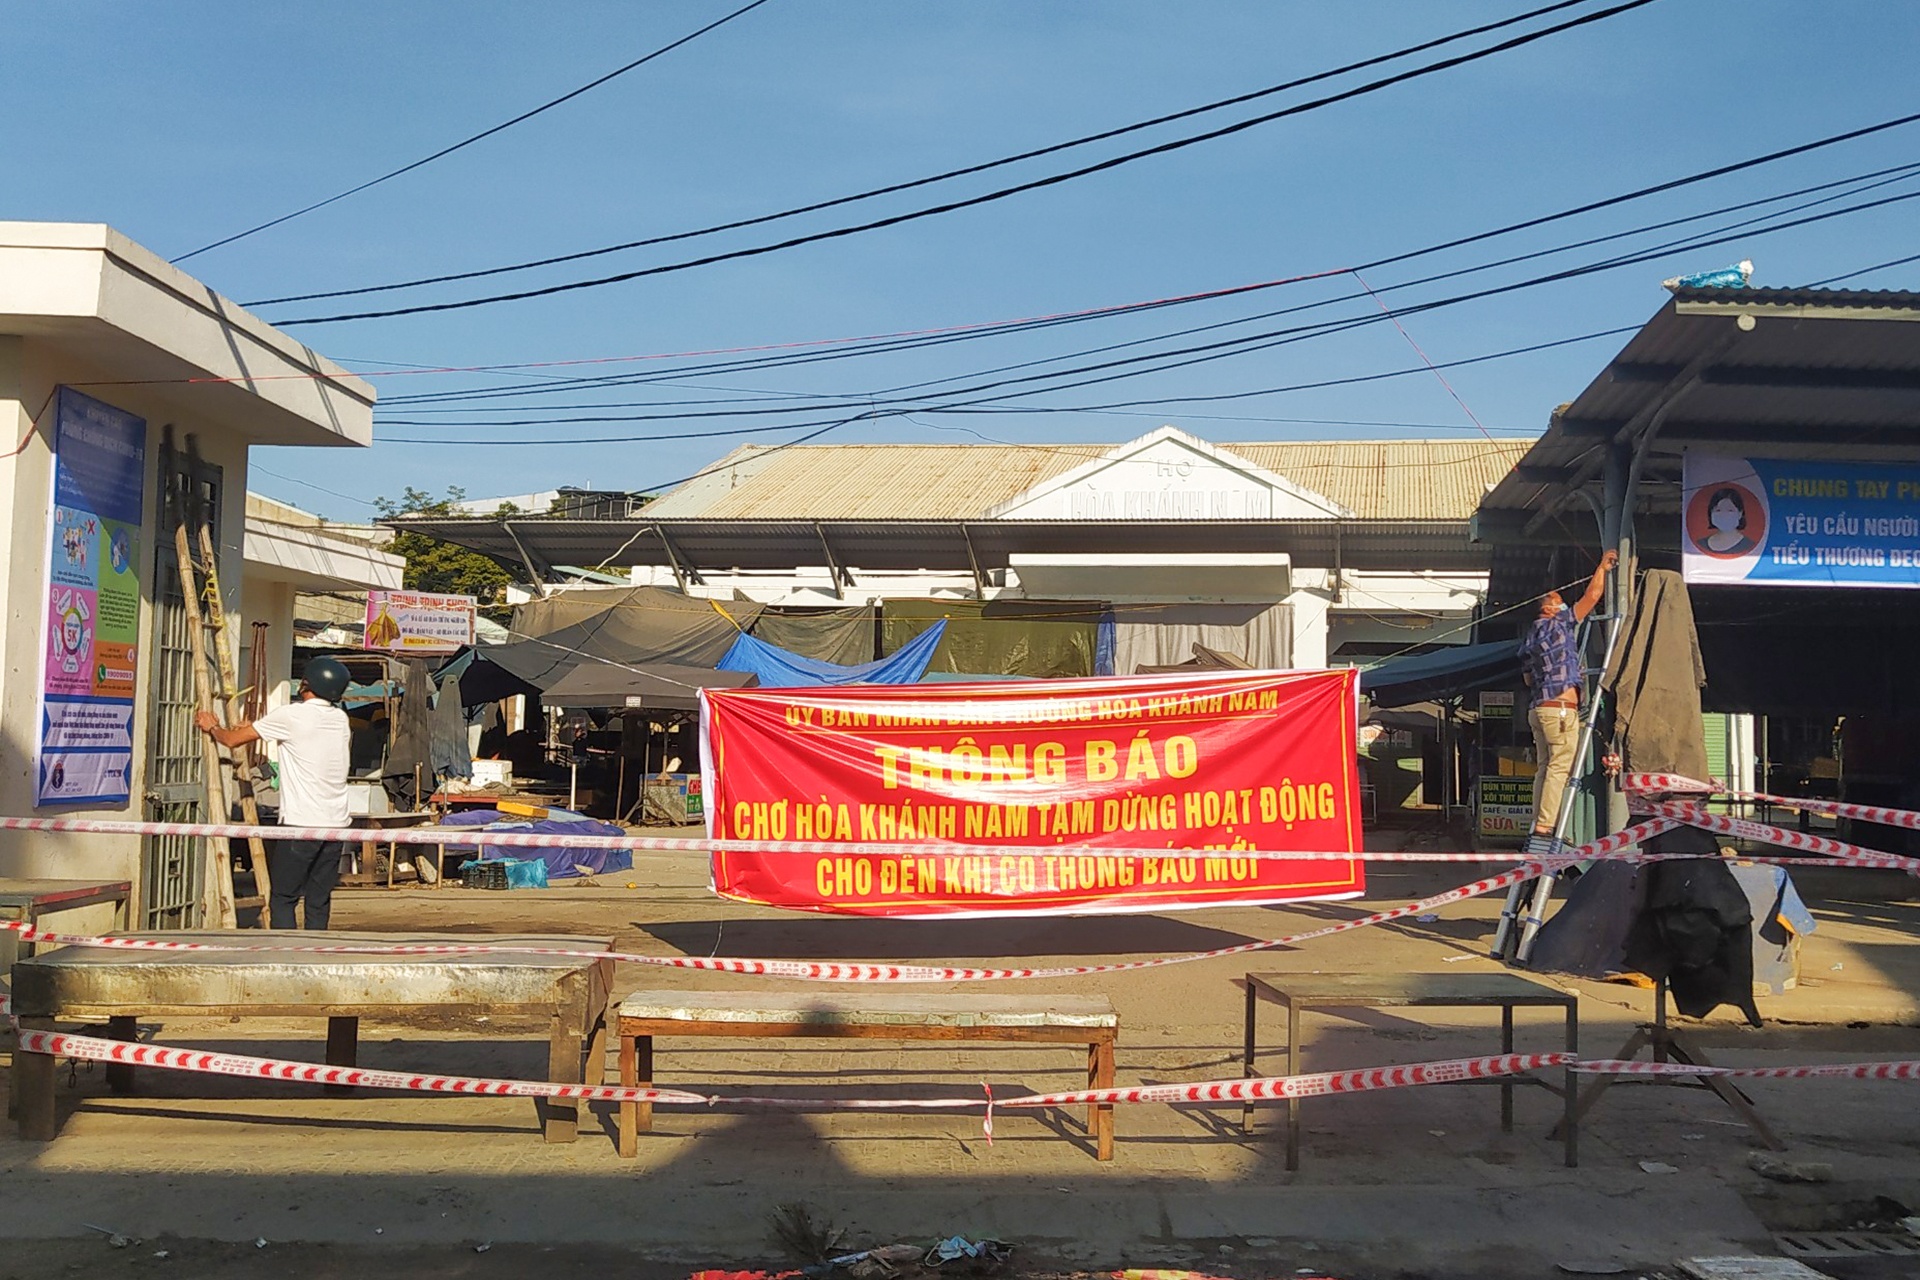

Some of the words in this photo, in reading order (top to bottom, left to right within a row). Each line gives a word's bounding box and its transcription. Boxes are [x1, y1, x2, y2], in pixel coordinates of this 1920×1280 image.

[1124, 483, 1205, 518] KHÁNH
[1211, 490, 1267, 518] NM
[1773, 478, 1848, 497] CHUNG
[1856, 480, 1889, 498] TAY
[1785, 513, 1818, 535] YÊU
[1772, 540, 1809, 565] TIỂU
[1815, 546, 1885, 567] THƯƠNG
[822, 706, 869, 727] BAN
[1148, 693, 1221, 717] KHÁNH
[1228, 689, 1278, 712] NAM
[874, 737, 1067, 789] THÔNG
[1085, 729, 1198, 783] BÁO
[795, 795, 852, 841] HÒA
[860, 798, 956, 841] KHÁNH
[964, 804, 1028, 838] NAM
[1036, 799, 1095, 842] TẠM
[1103, 791, 1177, 833] DỪNG
[1184, 789, 1253, 833] HOẠT
[1260, 778, 1335, 830] ĐỘNG
[1483, 816, 1514, 830] SỮA
[816, 858, 872, 897] CHO
[945, 856, 991, 895] KHI
[1142, 840, 1196, 885] BÁO
[1203, 836, 1258, 881] MỚI
